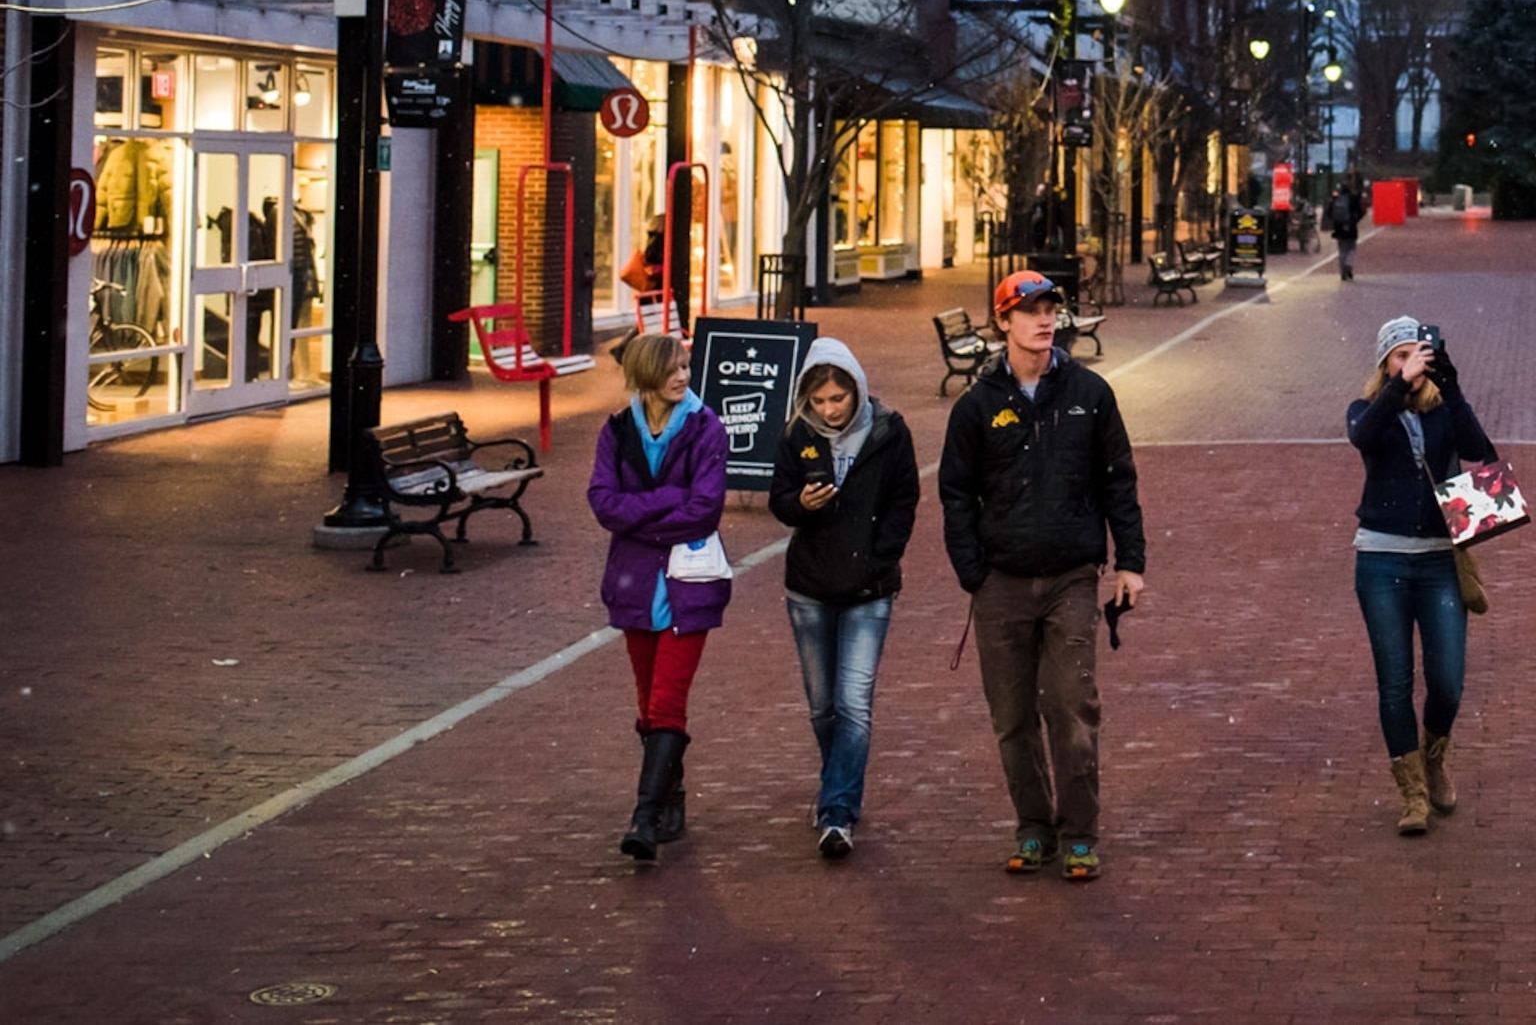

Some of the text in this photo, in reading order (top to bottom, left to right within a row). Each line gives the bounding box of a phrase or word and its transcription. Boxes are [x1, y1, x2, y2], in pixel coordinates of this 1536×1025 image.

[718, 360, 778, 376] OPEN
[729, 401, 756, 414] KEEP
[718, 411, 767, 425] VERMONT
[724, 422, 759, 435] WEIRD
